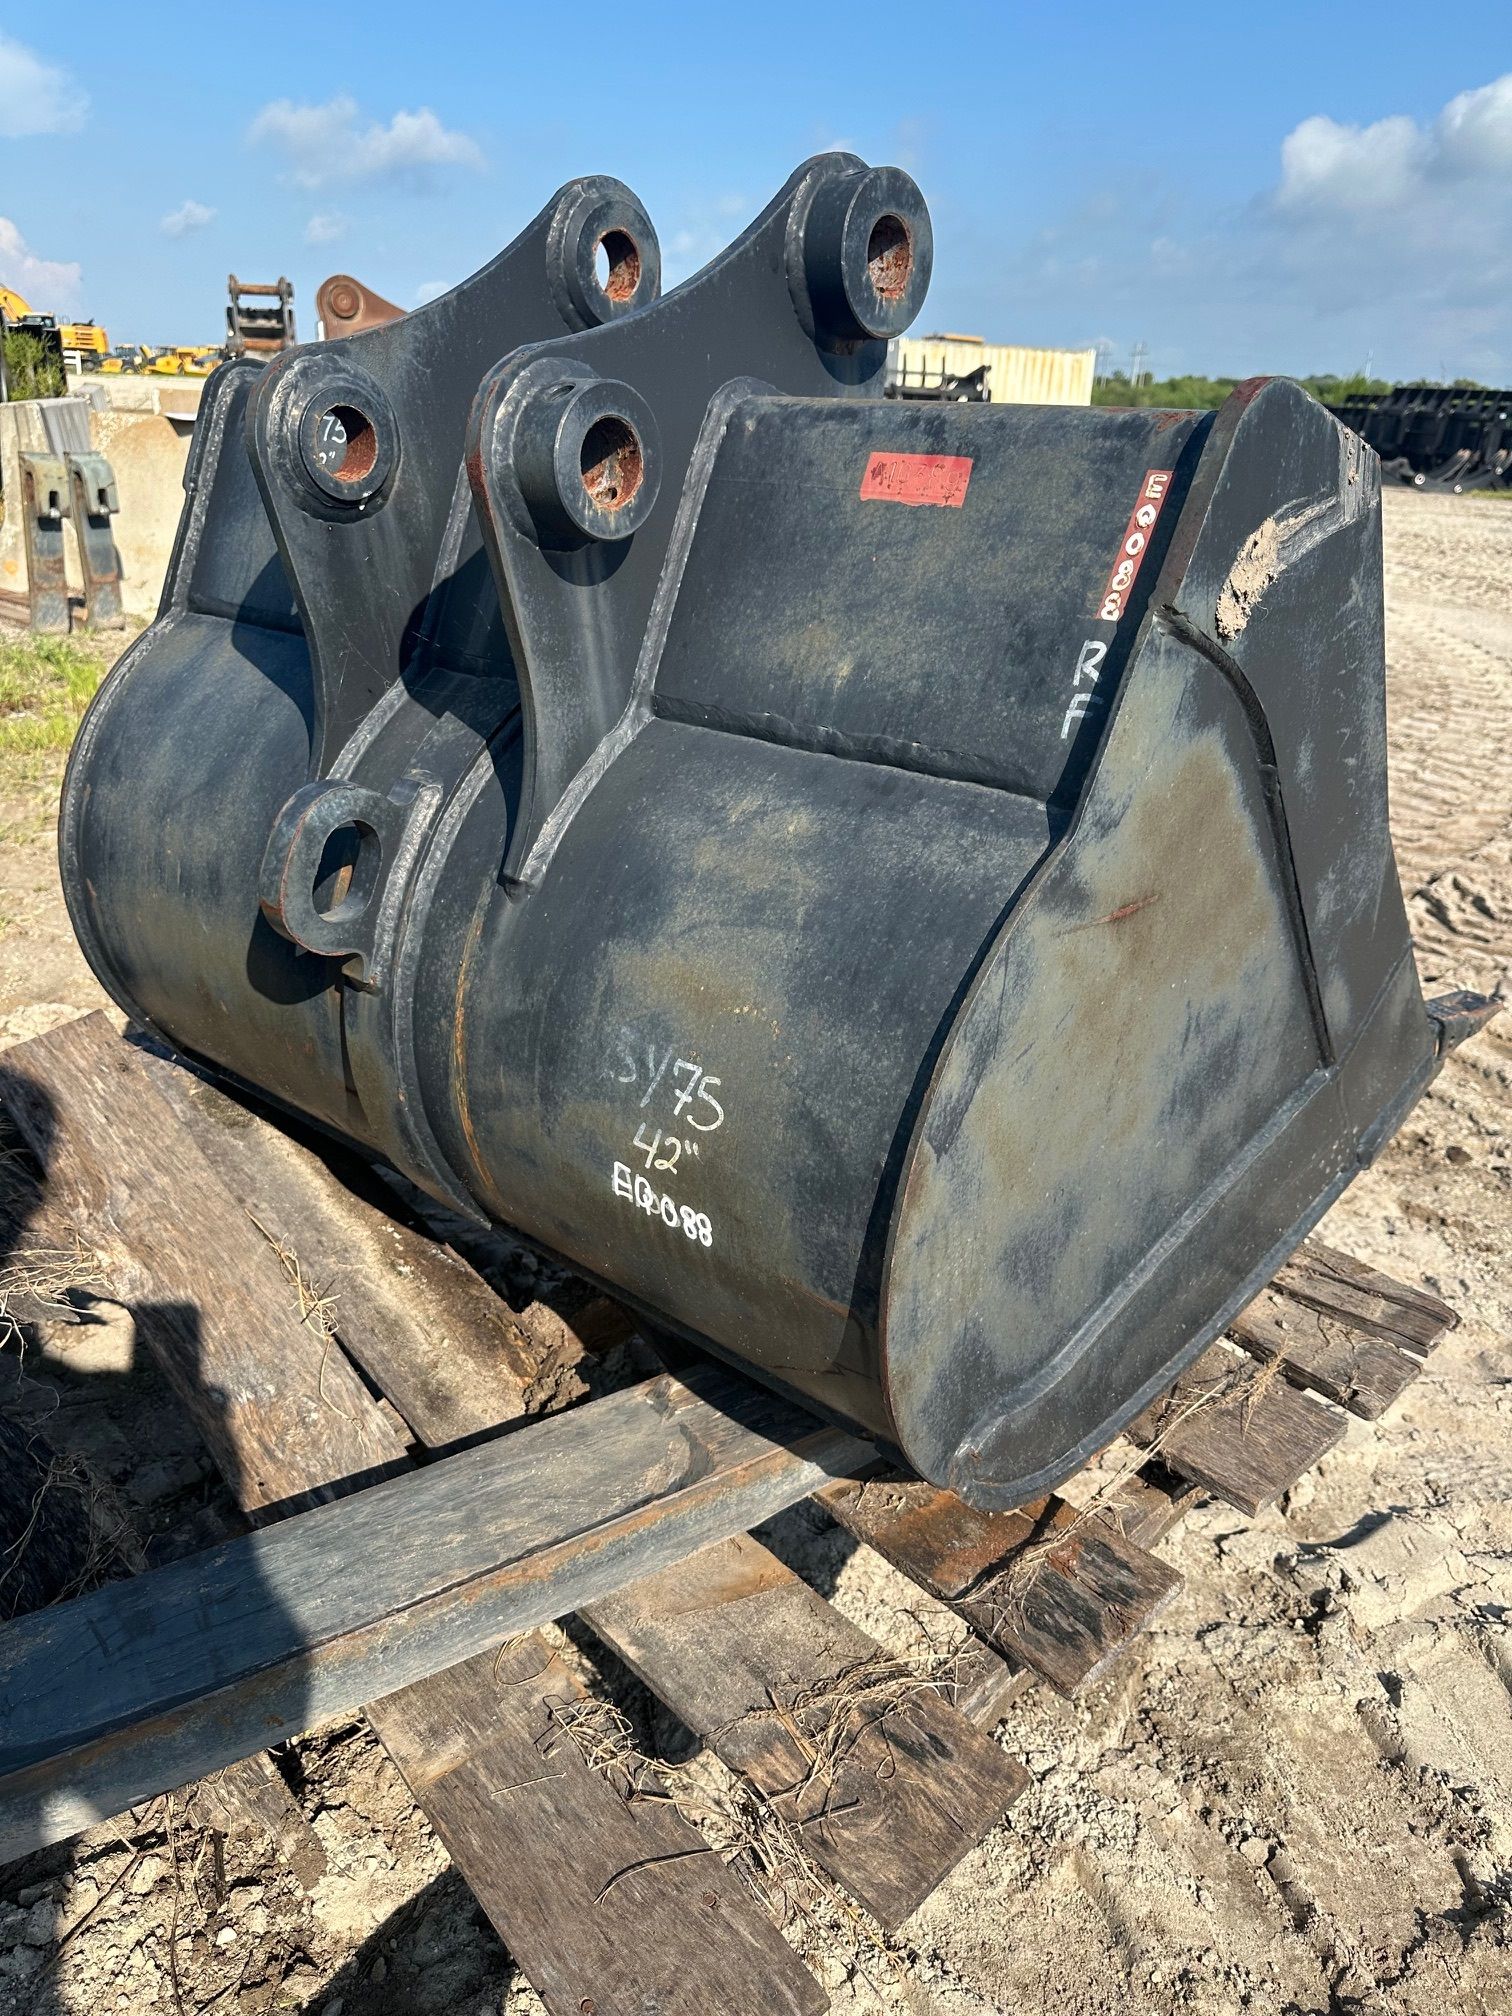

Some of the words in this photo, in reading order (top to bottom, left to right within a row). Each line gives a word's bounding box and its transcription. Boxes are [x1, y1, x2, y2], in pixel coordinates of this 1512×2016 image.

[322, 415, 347, 444] 75
[1100, 473, 1168, 621] EQ088
[632, 1122, 700, 1175] 42"
[611, 1160, 713, 1248] EQ088
